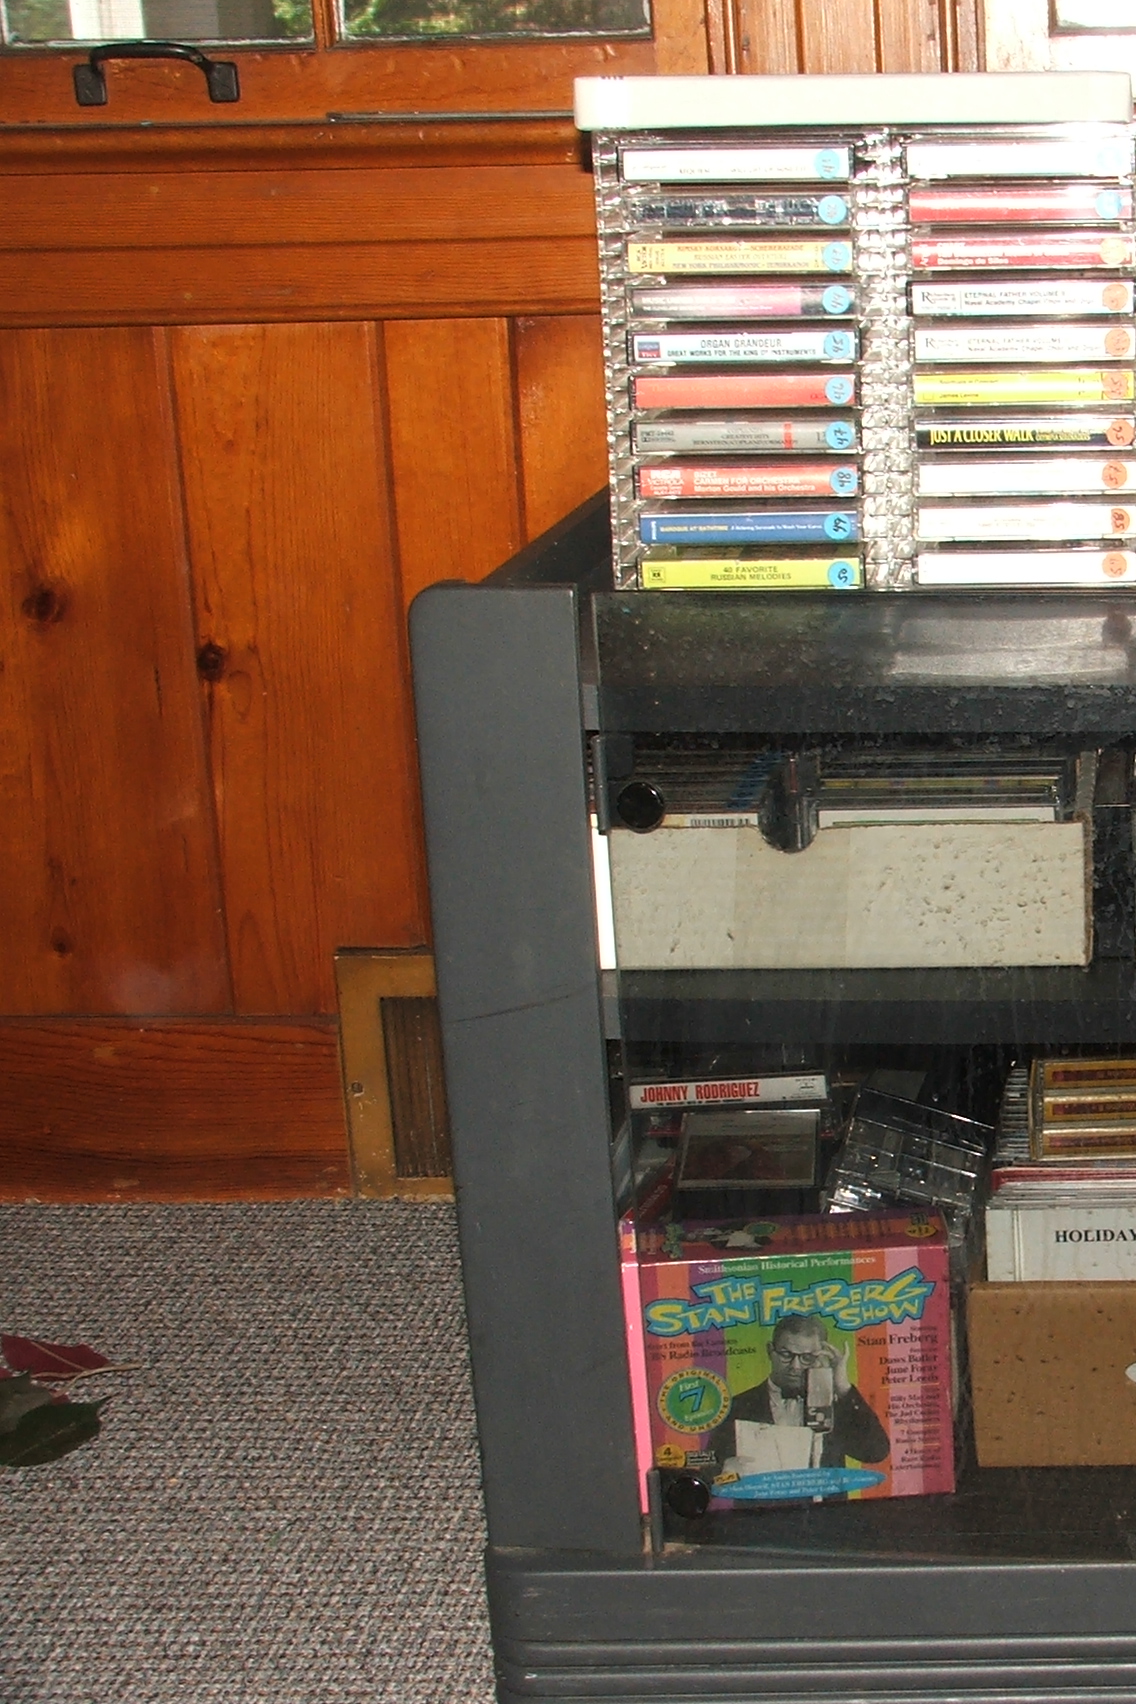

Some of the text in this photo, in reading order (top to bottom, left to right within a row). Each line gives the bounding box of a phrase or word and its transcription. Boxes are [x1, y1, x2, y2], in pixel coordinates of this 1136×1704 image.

[1018, 298, 1041, 306] Chapel
[700, 339, 782, 349] ORGAN GRANDEUR
[832, 336, 845, 353] 45
[834, 428, 849, 445] 47
[930, 430, 953, 445] JUST
[954, 430, 963, 443] A
[963, 430, 1003, 443] CLOSER
[1004, 430, 1035, 442] WALK
[750, 477, 800, 485] ORCHESTRA
[838, 472, 852, 488] 48
[832, 517, 847, 533] 49
[1113, 512, 1126, 529] 58
[749, 573, 791, 581] MELODIES
[640, 1082, 761, 1103] JOHNNY RODRIGUEZ
[698, 1256, 877, 1275] Smithsonian Historical Performances
[700, 1282, 757, 1305] THE
[649, 1304, 750, 1333] STAN
[836, 1301, 919, 1330] SHOW
[858, 1332, 938, 1346] Stan Freberg
[669, 1347, 756, 1360] Radio Broadcasts
[879, 1354, 938, 1365] Daws Butler
[885, 1364, 938, 1375] June Foray
[671, 1371, 722, 1386] ORIGINAL
[680, 1380, 700, 1392] First
[881, 1373, 939, 1386] Peter Leeds
[679, 1386, 706, 1413] 7
[666, 1414, 685, 1430] AND
[664, 1447, 672, 1456] 4
